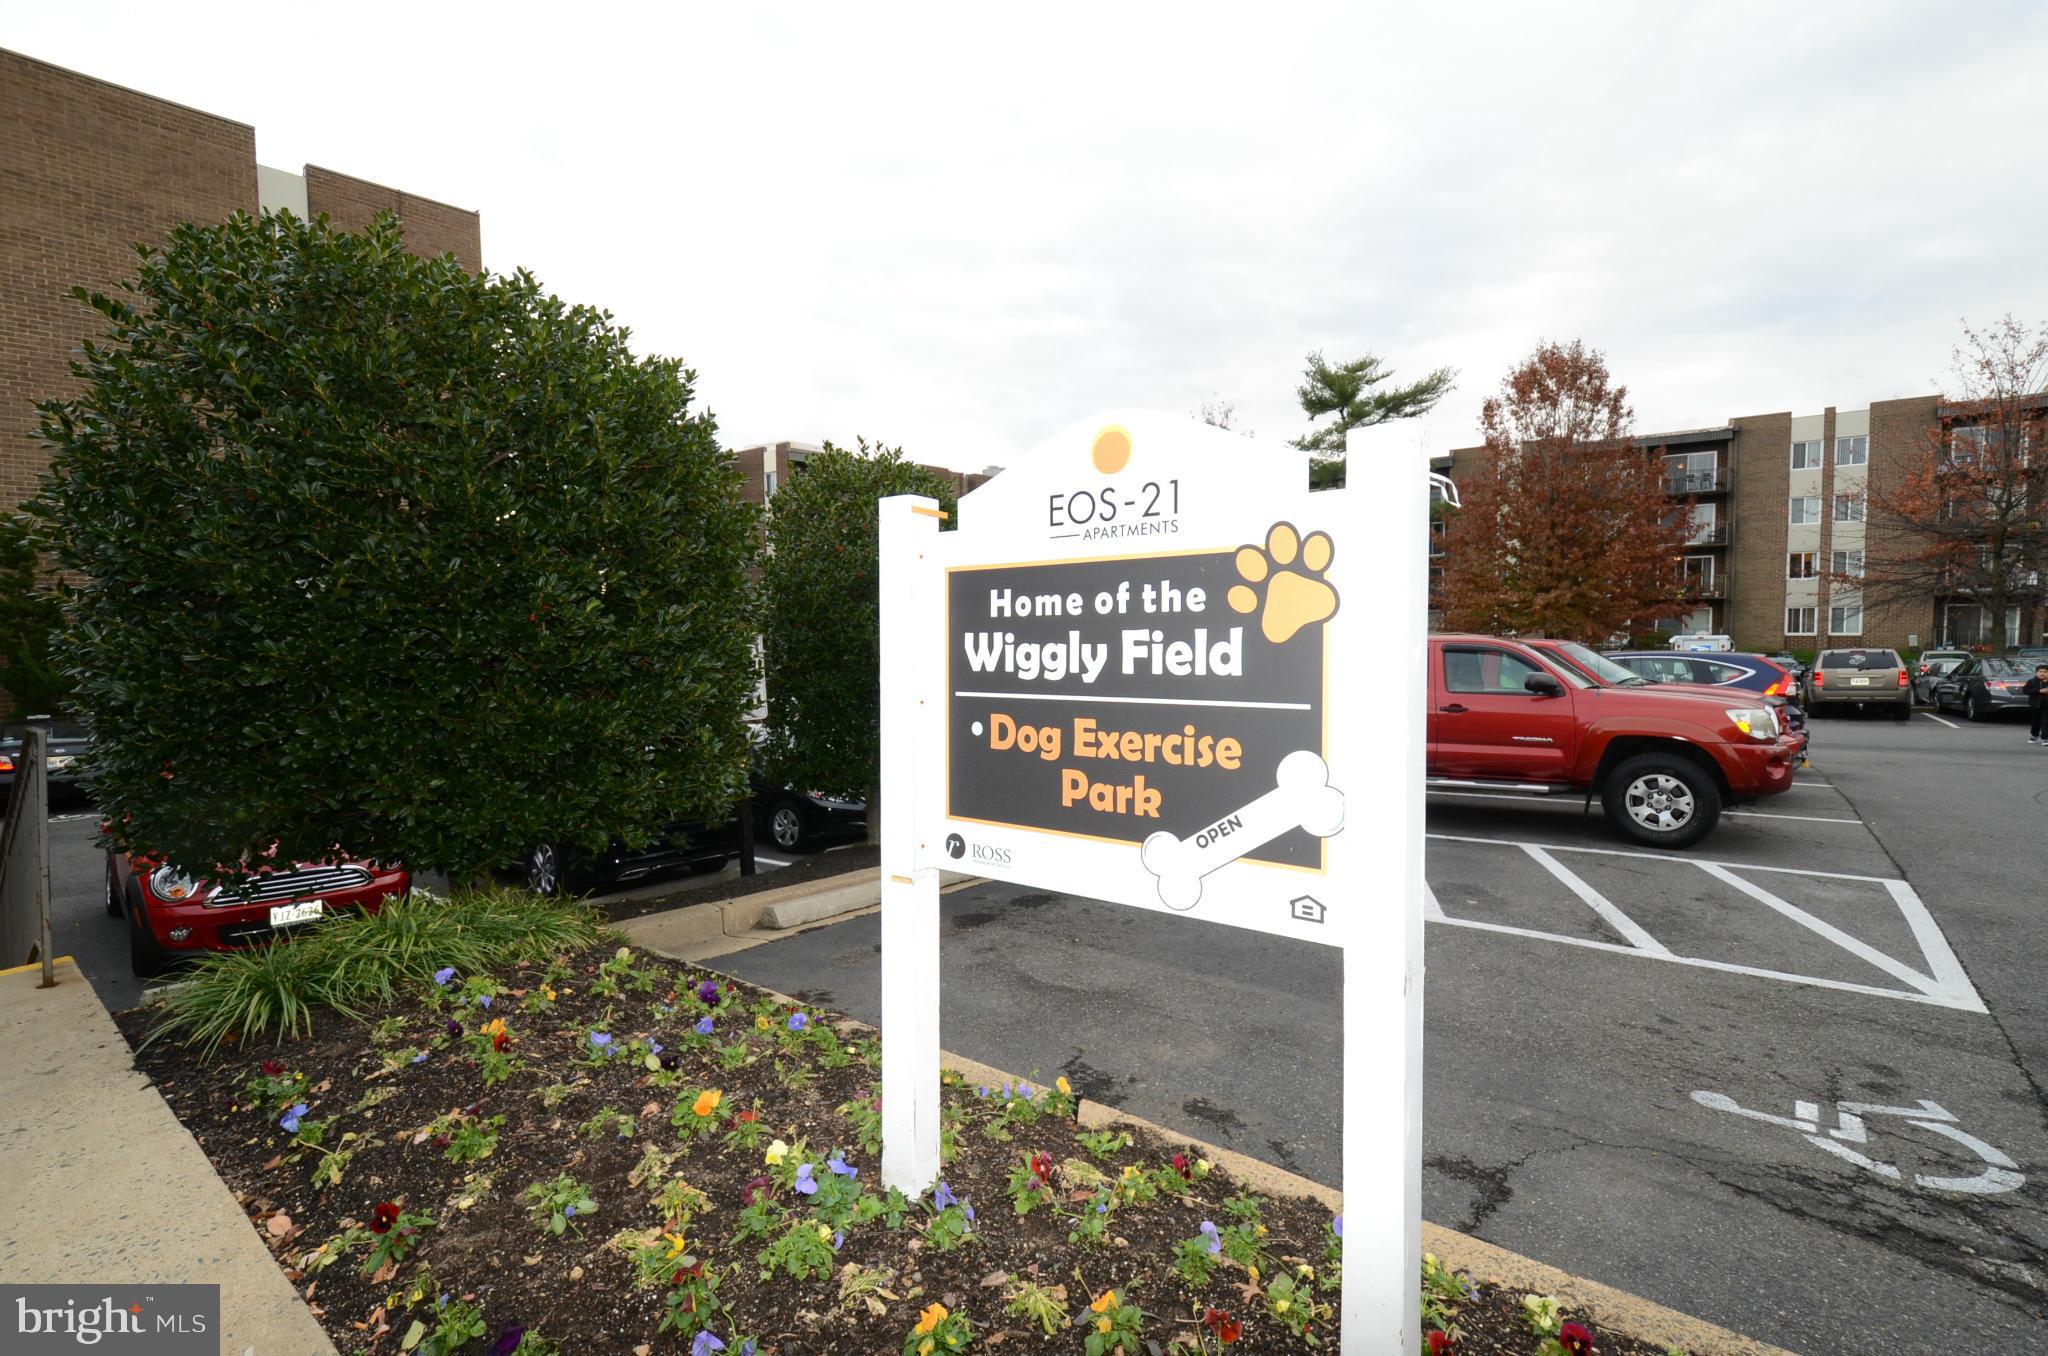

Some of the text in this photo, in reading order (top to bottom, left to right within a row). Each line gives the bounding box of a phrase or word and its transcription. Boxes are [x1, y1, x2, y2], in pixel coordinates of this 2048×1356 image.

[1050, 479, 1179, 526] EOS-21
[1083, 519, 1179, 541] APARTMENTS
[990, 580, 1206, 617] Home of the
[964, 627, 1243, 683] Wiggly Field
[990, 713, 1242, 770] Dog Exercise
[1062, 768, 1162, 818] Park
[1196, 815, 1243, 848] OPEN
[972, 844, 1011, 863] ROSS
